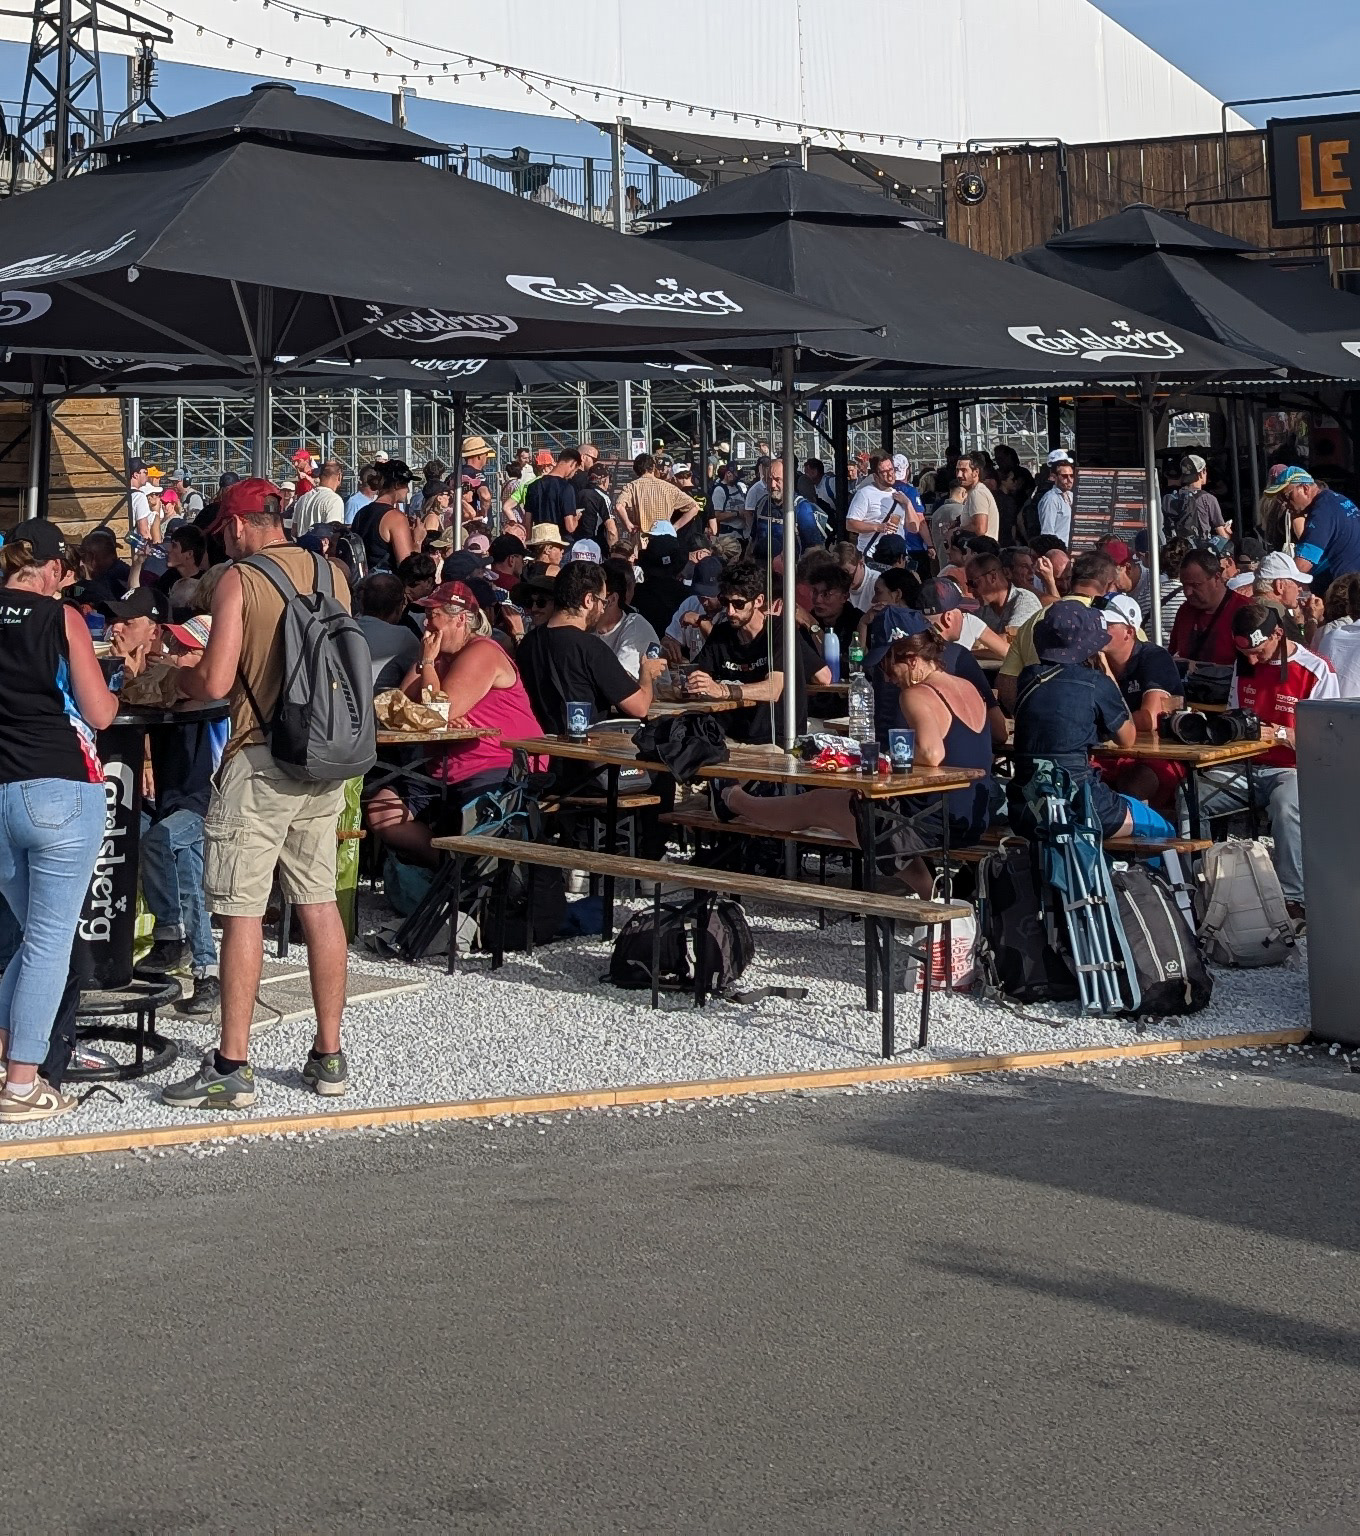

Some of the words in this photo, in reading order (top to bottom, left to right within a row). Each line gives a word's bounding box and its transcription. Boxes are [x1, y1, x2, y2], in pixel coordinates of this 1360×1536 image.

[1297, 134, 1352, 211] LE
[505, 274, 744, 315] Carlsberg
[1007, 321, 1185, 363] Carlsberg
